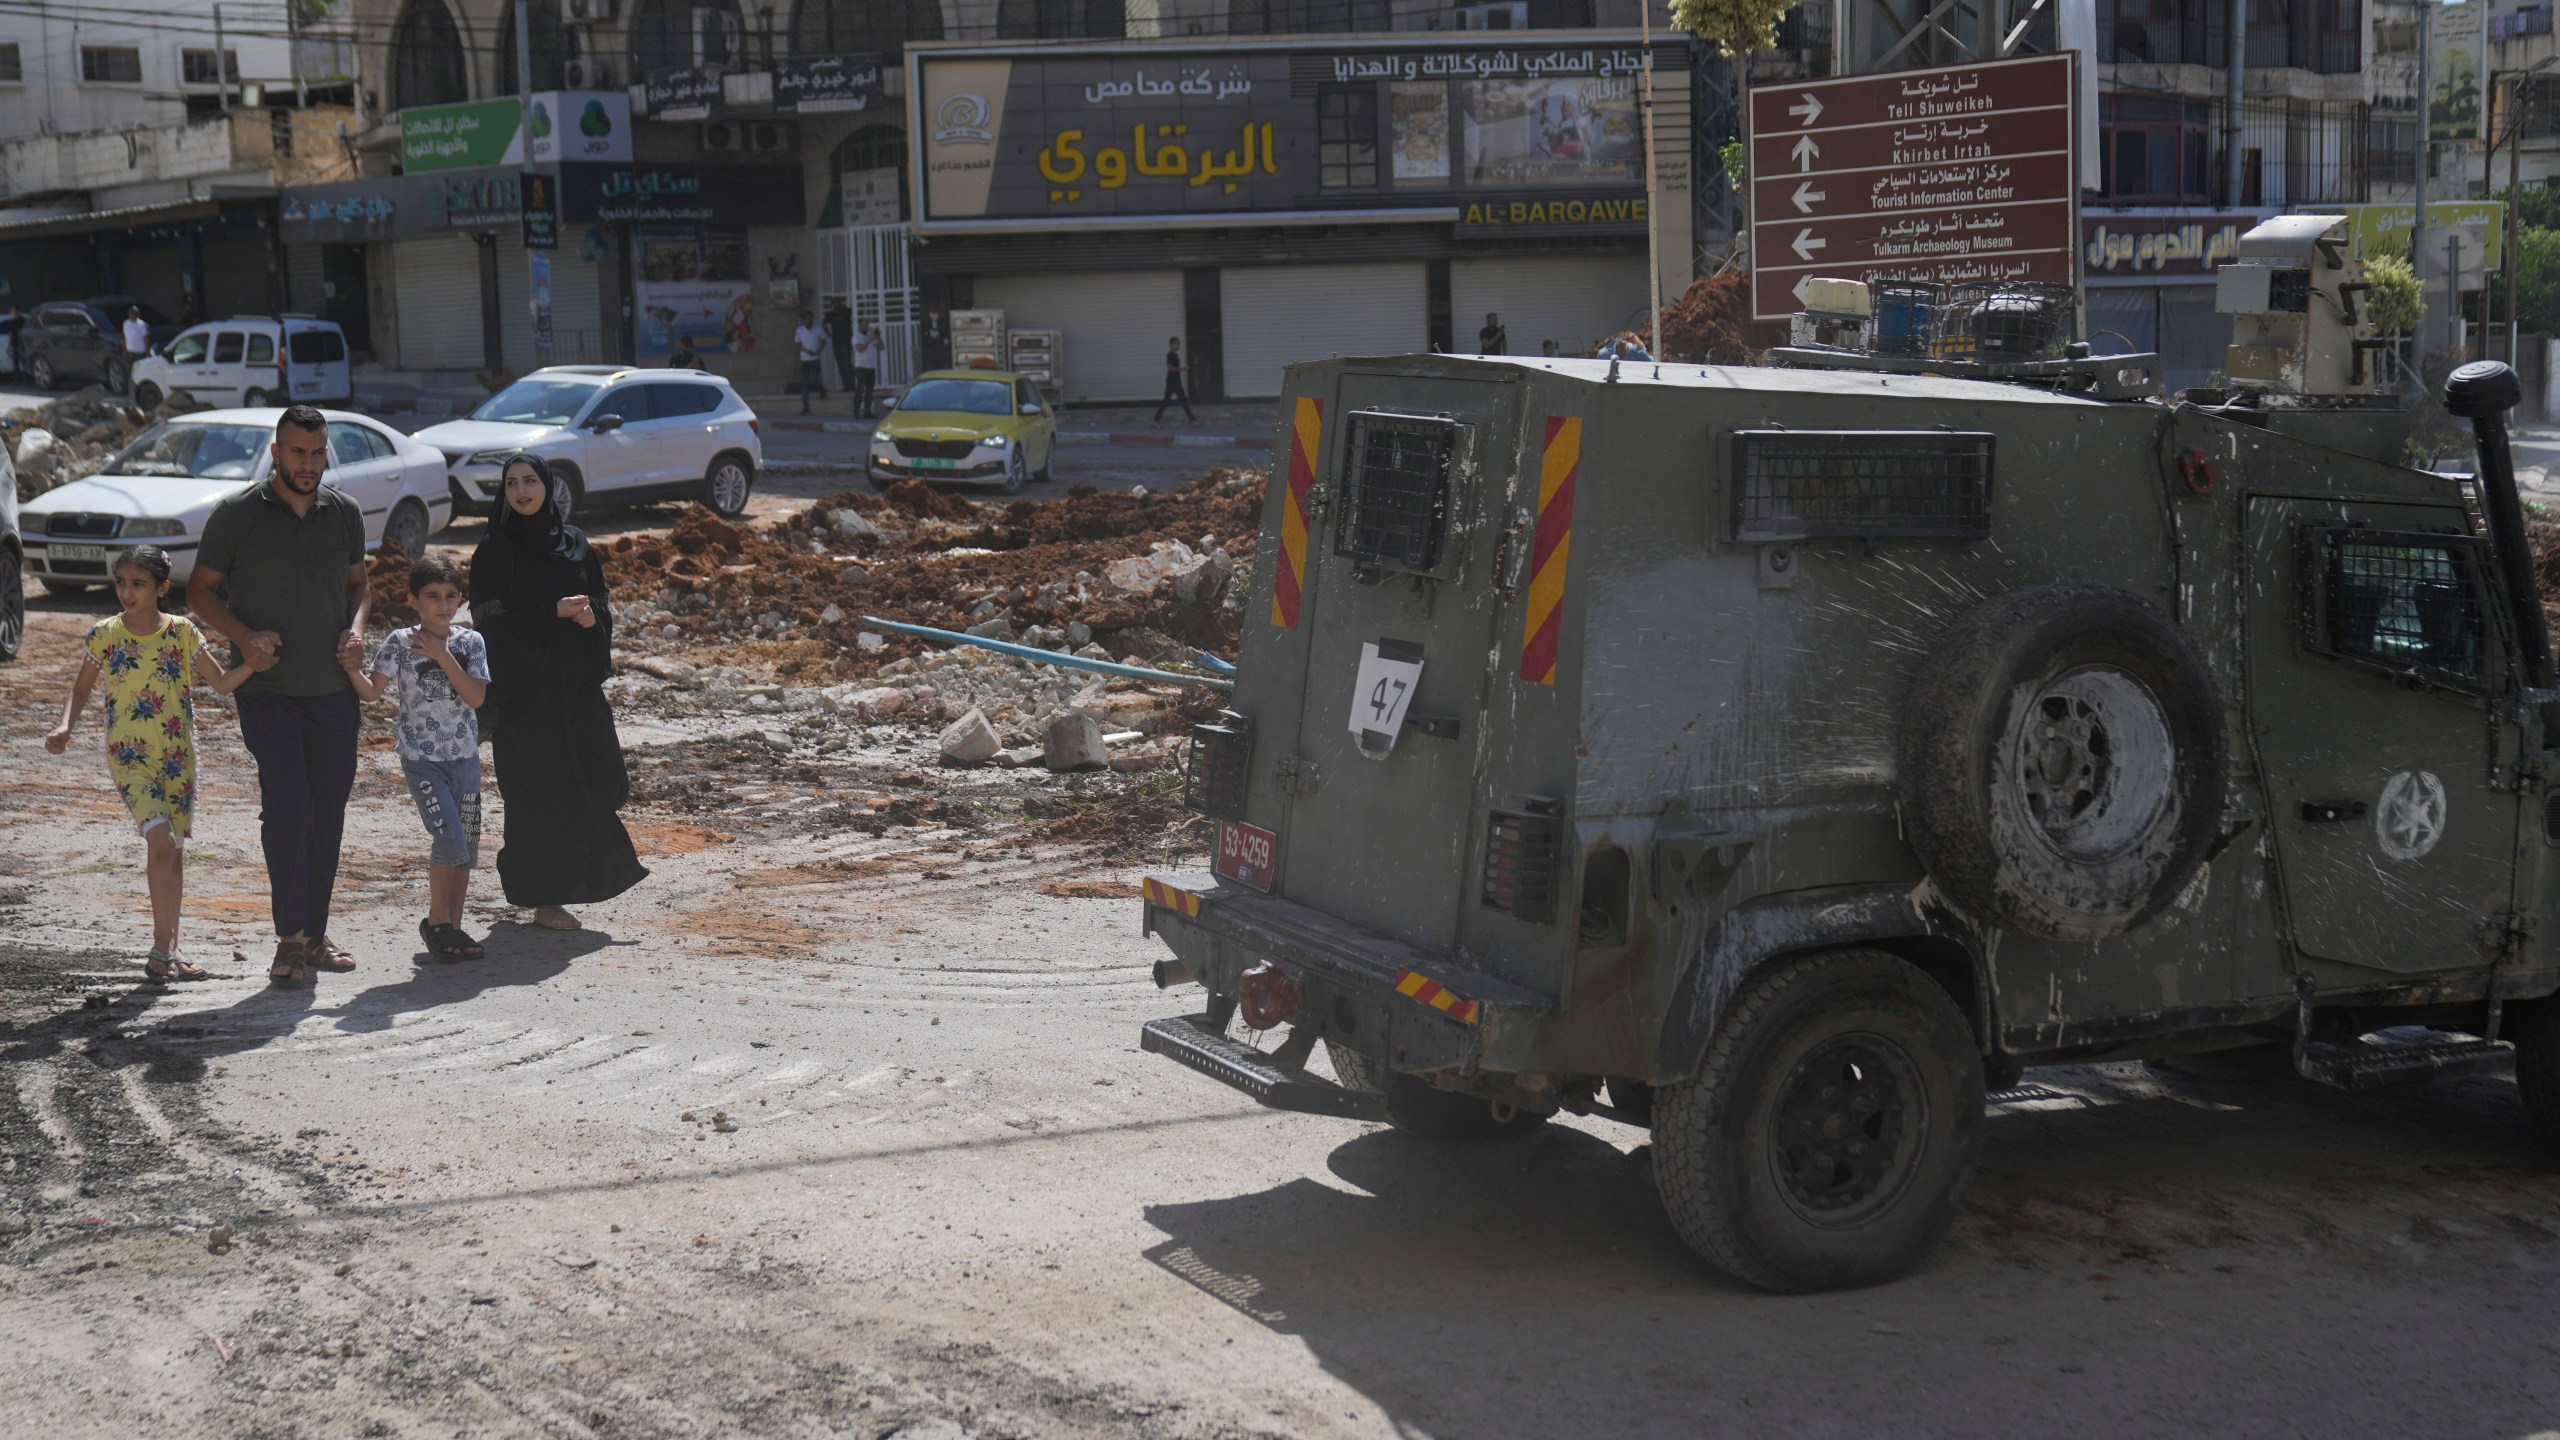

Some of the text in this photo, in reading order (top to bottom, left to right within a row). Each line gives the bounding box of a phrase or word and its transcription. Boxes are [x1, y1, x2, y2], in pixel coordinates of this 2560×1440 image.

[1333, 50, 1653, 82] الجناح الملكي لشوكلاتة و الهدايا
[1084, 63, 1251, 103] شركة محامص
[1901, 73, 1979, 98] تل شويكة
[1888, 94, 1993, 119] Tell Shuweikeh
[1894, 119, 1989, 145] خربة إرتاح
[1038, 121, 1277, 203] البرقاوي
[1893, 142, 1991, 164] Khirbet Irtah
[602, 171, 703, 202] سكاي تل
[1872, 164, 2011, 194] مركز الإستعلامات السياحي
[1870, 185, 2014, 209] Tourist Information Center
[1465, 199, 1648, 224] AL-BARQAWE
[2376, 207, 2416, 233] شاوي
[1880, 212, 2005, 238] متحف آثار طولكرم
[1873, 235, 2013, 257] Tulkarm Archaeology Museum
[2085, 225, 2241, 271] الم اللحوم مول
[1938, 260, 1986, 284] العثمانية
[1990, 261, 2030, 281] السرايا
[1370, 677, 1407, 725] 47
[1225, 826, 1269, 869] 53-4259
